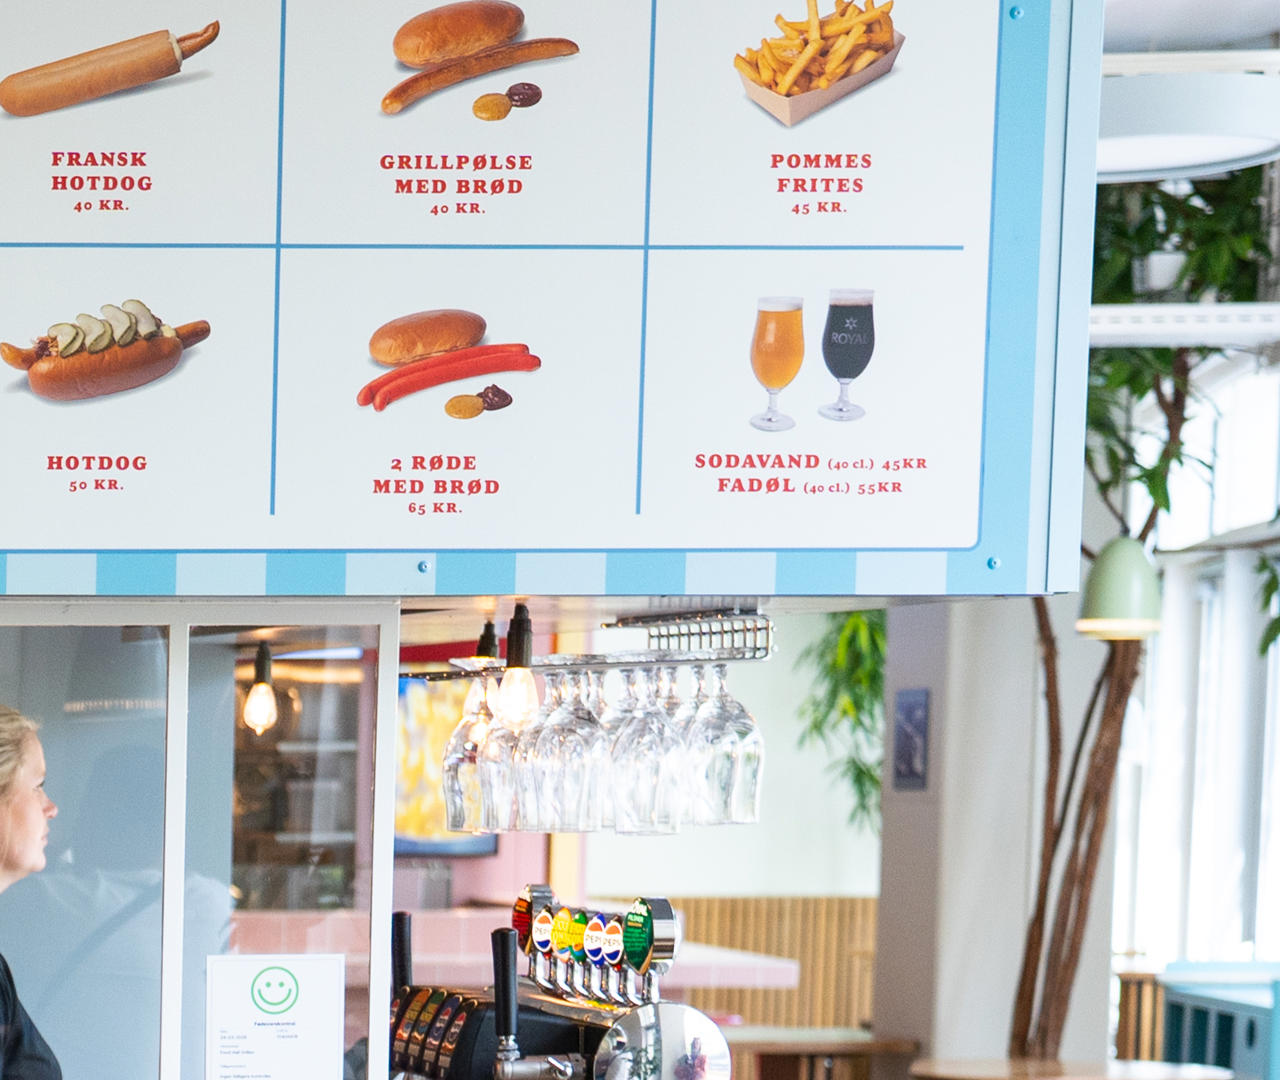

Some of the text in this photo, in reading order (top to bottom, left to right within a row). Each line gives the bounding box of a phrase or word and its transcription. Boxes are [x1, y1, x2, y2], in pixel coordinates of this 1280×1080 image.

[51, 151, 147, 167] FRANSK
[379, 154, 533, 171] GRILLPØLSE
[771, 153, 873, 169] POMMES
[51, 175, 153, 192] HOTDOG
[395, 178, 523, 195] MED BRØD
[777, 177, 864, 193] FRITES
[73, 199, 130, 213] 40 KR.
[430, 202, 486, 216] 40 KR.
[791, 201, 848, 215] 45 KR.
[831, 332, 869, 345] ROYAL
[47, 455, 147, 472] HOTDOG
[391, 454, 476, 471] 2 RØDE
[695, 453, 927, 471] SODAVAND (40 cl.) 45KR
[69, 478, 125, 493] 50 KR.
[373, 479, 500, 495] MED BRØD
[718, 476, 902, 495] FADØL (40 cl.) 55KR
[407, 501, 463, 516] 65 KR.
